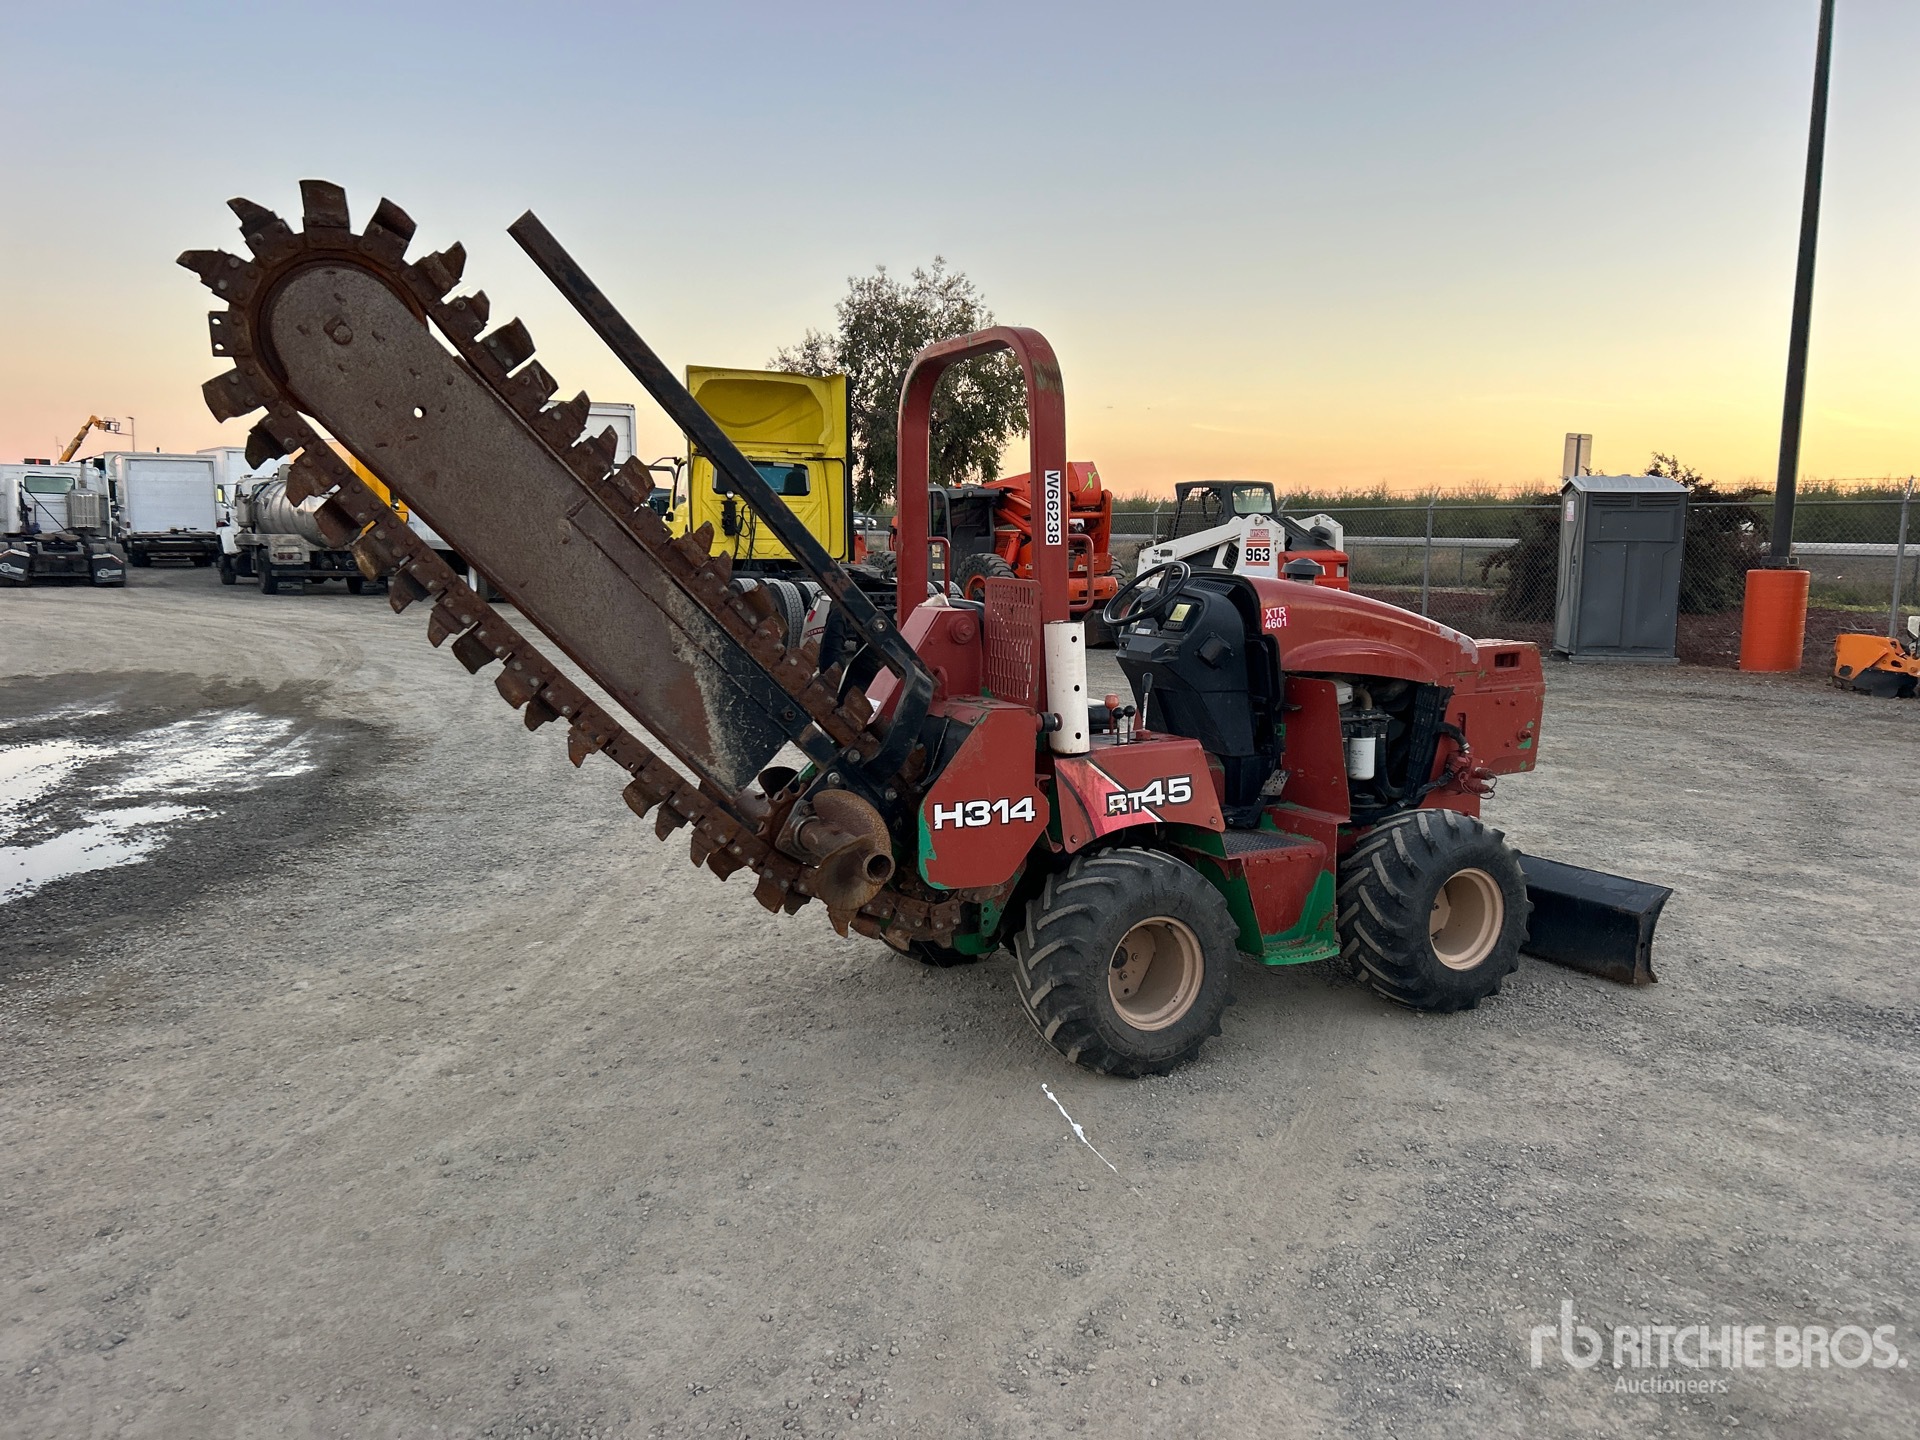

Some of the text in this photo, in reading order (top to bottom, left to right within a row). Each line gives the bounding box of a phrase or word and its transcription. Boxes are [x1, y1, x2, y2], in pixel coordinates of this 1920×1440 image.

[1046, 471, 1060, 544] W66238
[1245, 547, 1271, 562] 963
[1264, 616, 1287, 630] 4601
[1265, 606, 1287, 619] XTR
[1106, 775, 1192, 815] RT45
[933, 796, 1036, 831] H314
